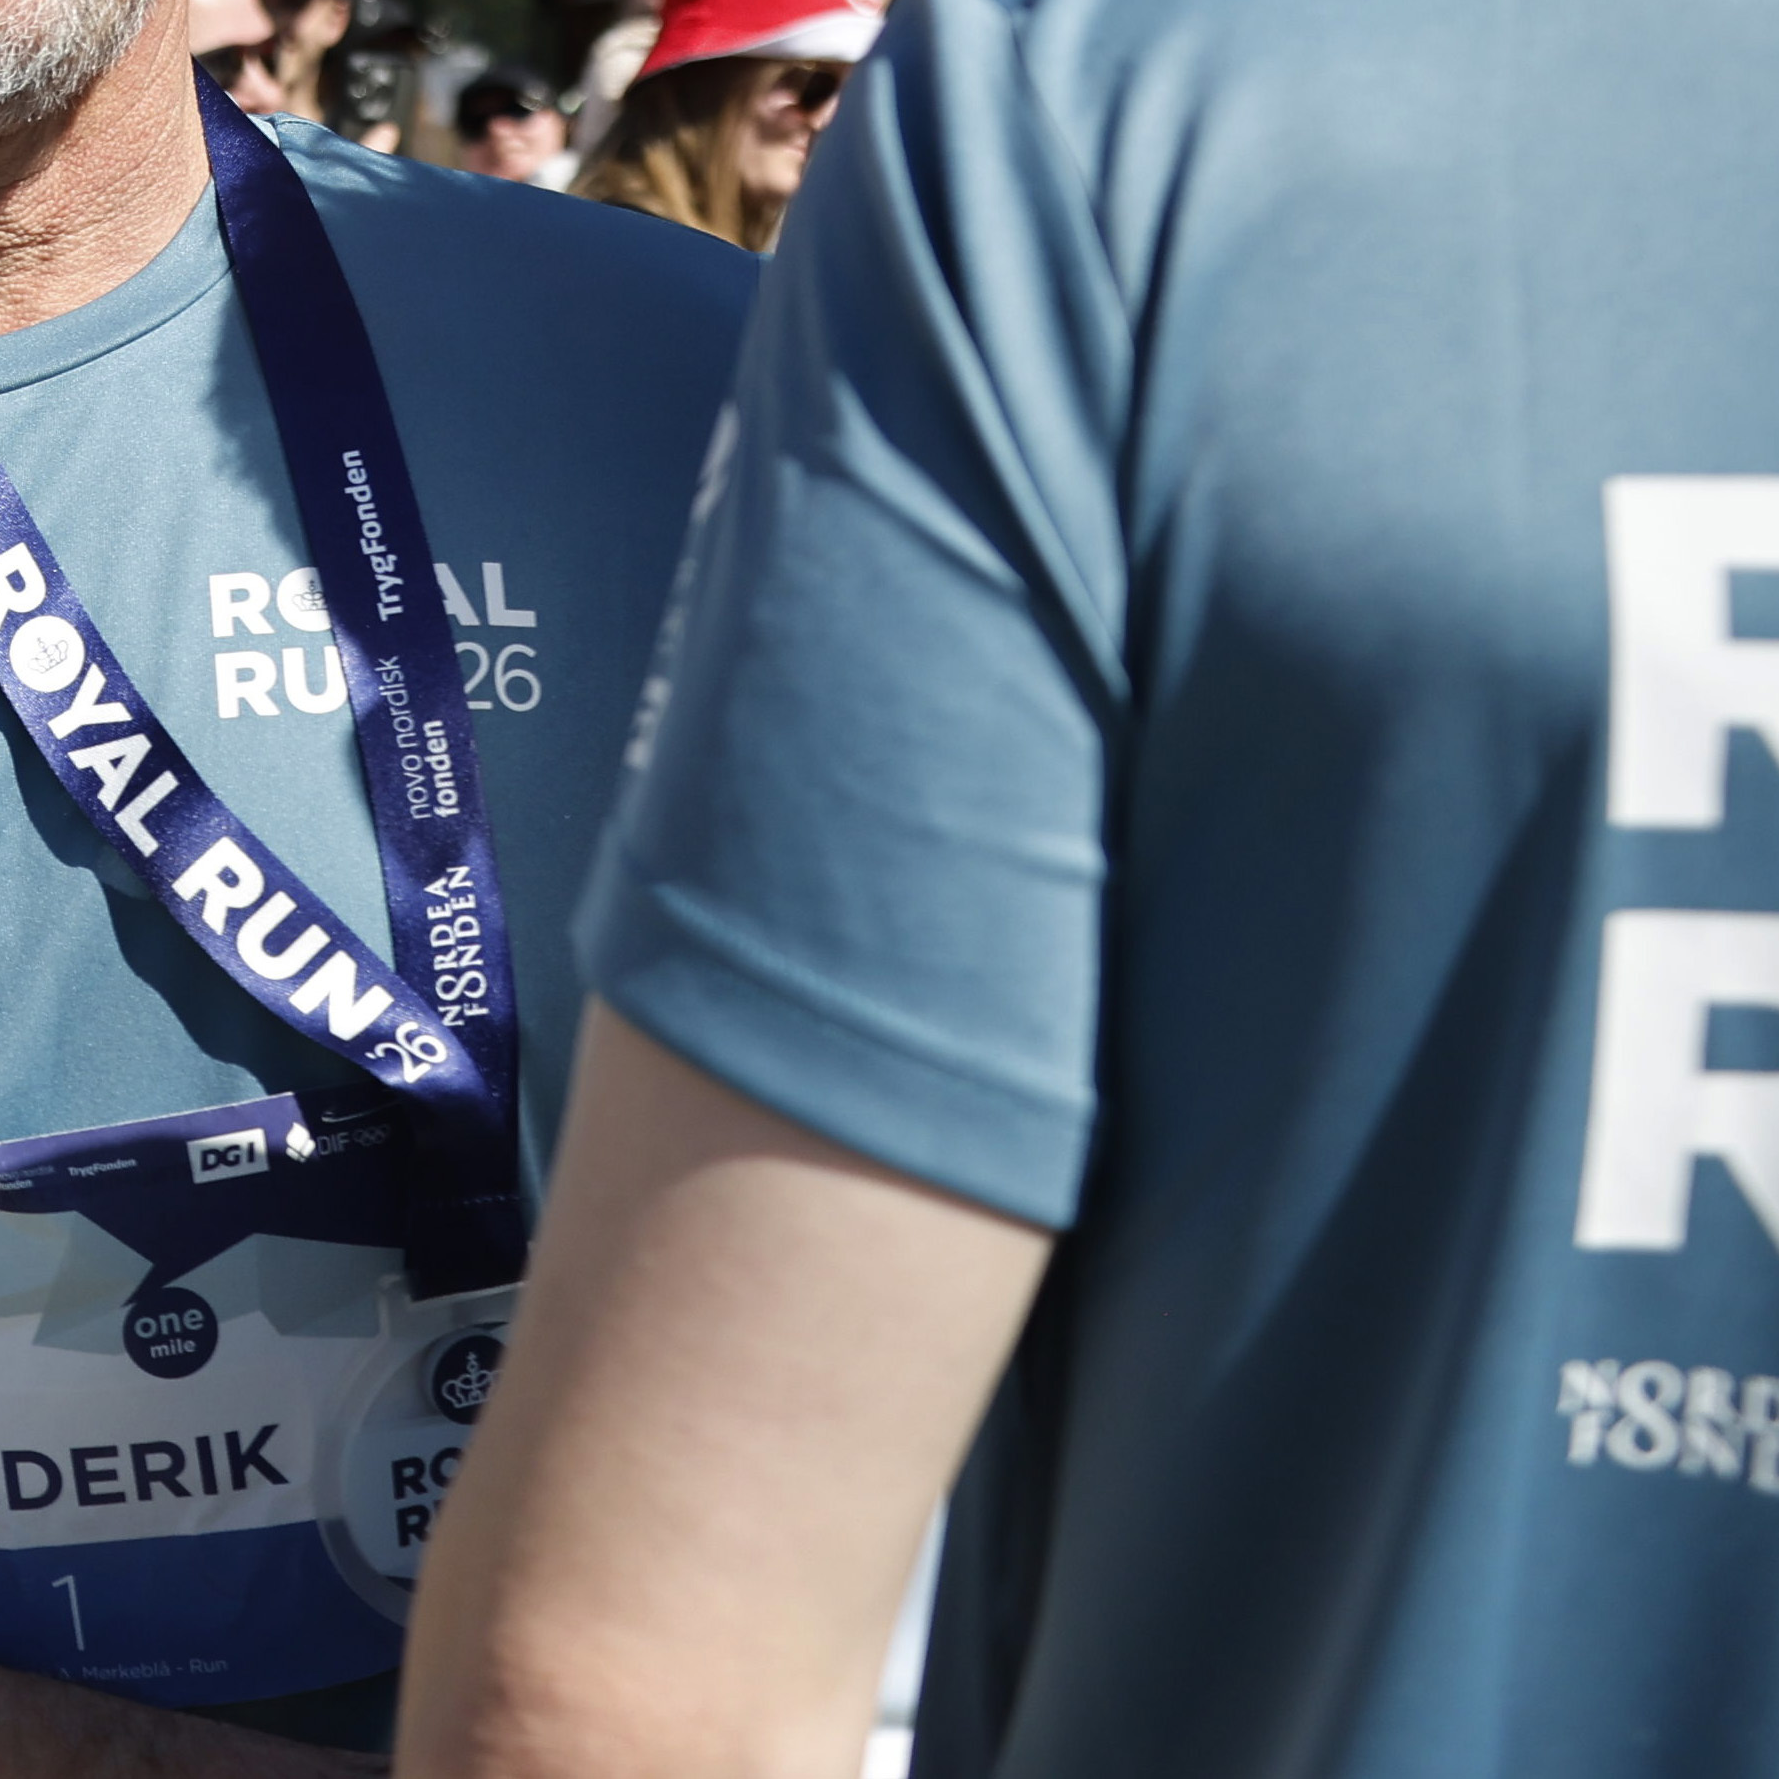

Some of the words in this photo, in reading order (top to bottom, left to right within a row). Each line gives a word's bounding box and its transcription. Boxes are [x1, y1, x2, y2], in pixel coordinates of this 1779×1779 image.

[341, 449, 405, 623] TrygFonden
[374, 655, 418, 749] nordisk
[400, 753, 431, 820] novo
[422, 720, 460, 818] fonden
[423, 876, 466, 1027] NORDEA
[446, 864, 490, 1018] FONDEN
[199, 1141, 257, 1172] DGI
[316, 1132, 351, 1156] DIF
[133, 1307, 205, 1339] one
[149, 1336, 197, 1359] mile
[51, 1574, 85, 1652] 1
[188, 1658, 229, 1675] Run
